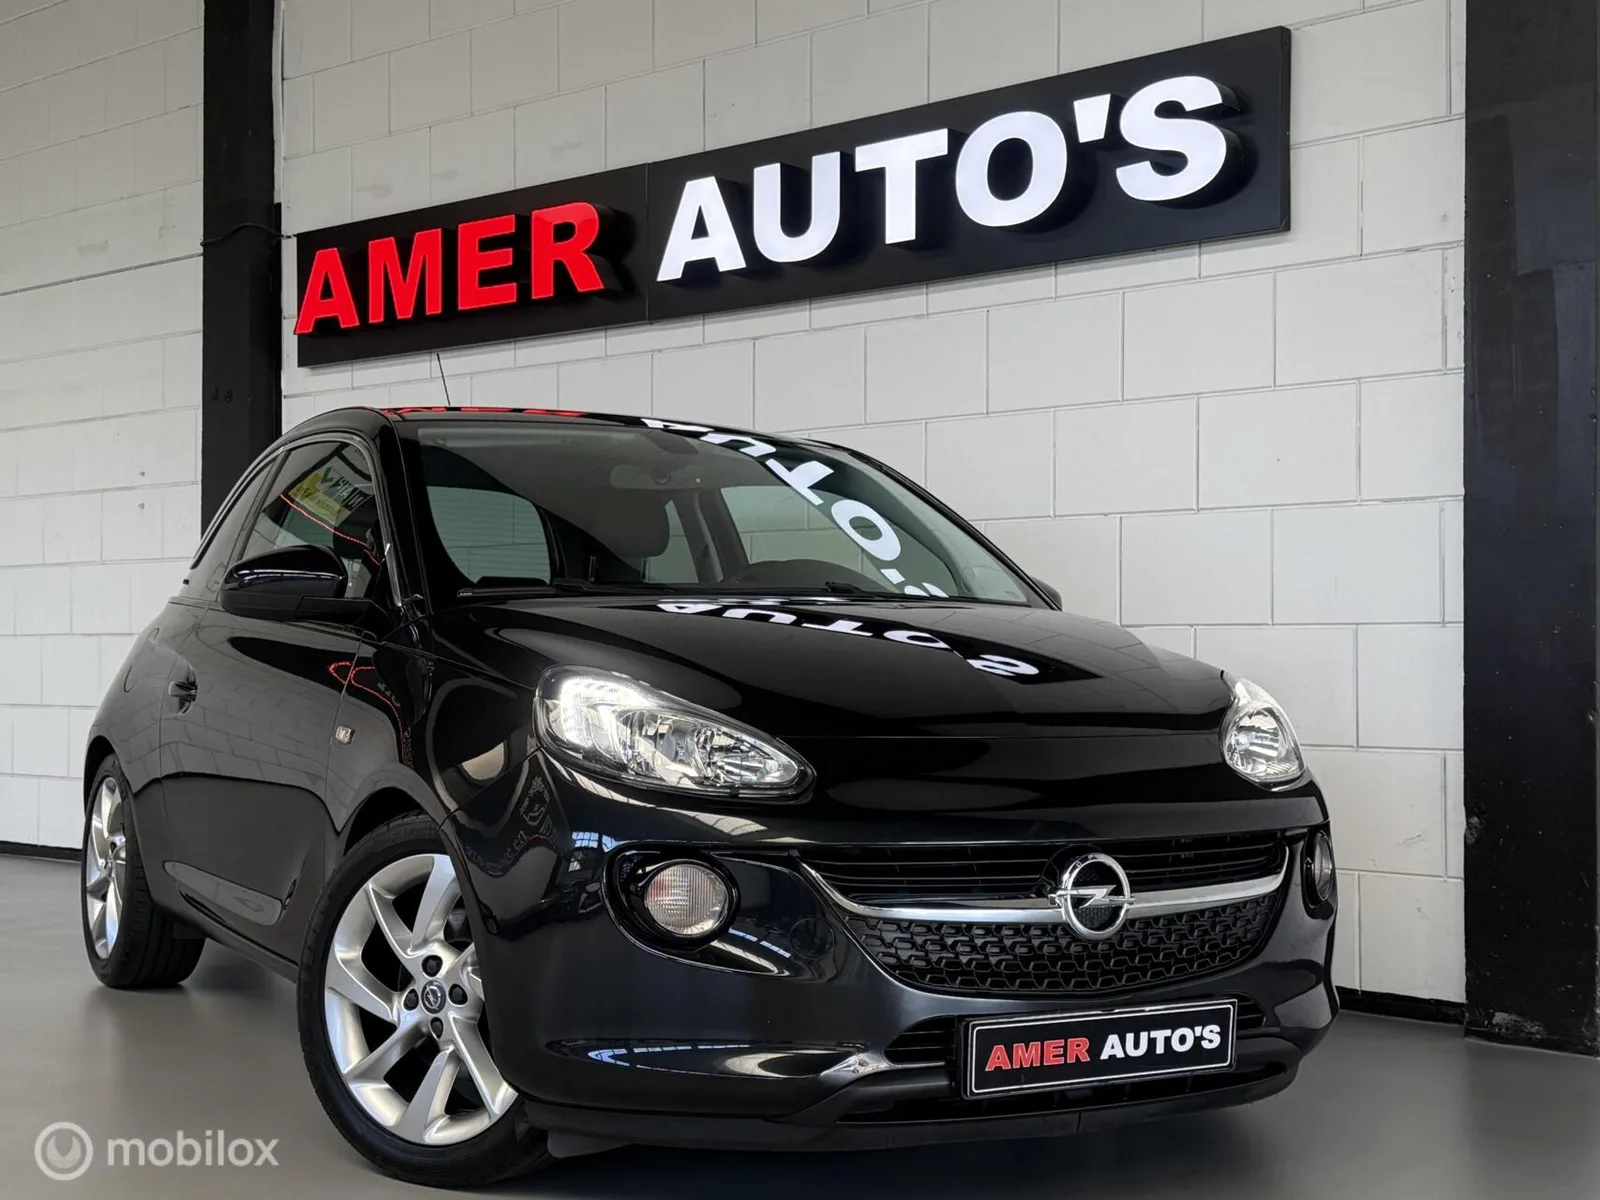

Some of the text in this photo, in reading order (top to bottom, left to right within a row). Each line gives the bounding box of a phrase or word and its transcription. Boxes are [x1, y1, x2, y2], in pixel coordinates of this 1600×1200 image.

[293, 75, 1227, 336] AMER AUTO'S
[985, 1024, 1221, 1071] AMER AUTO'S
